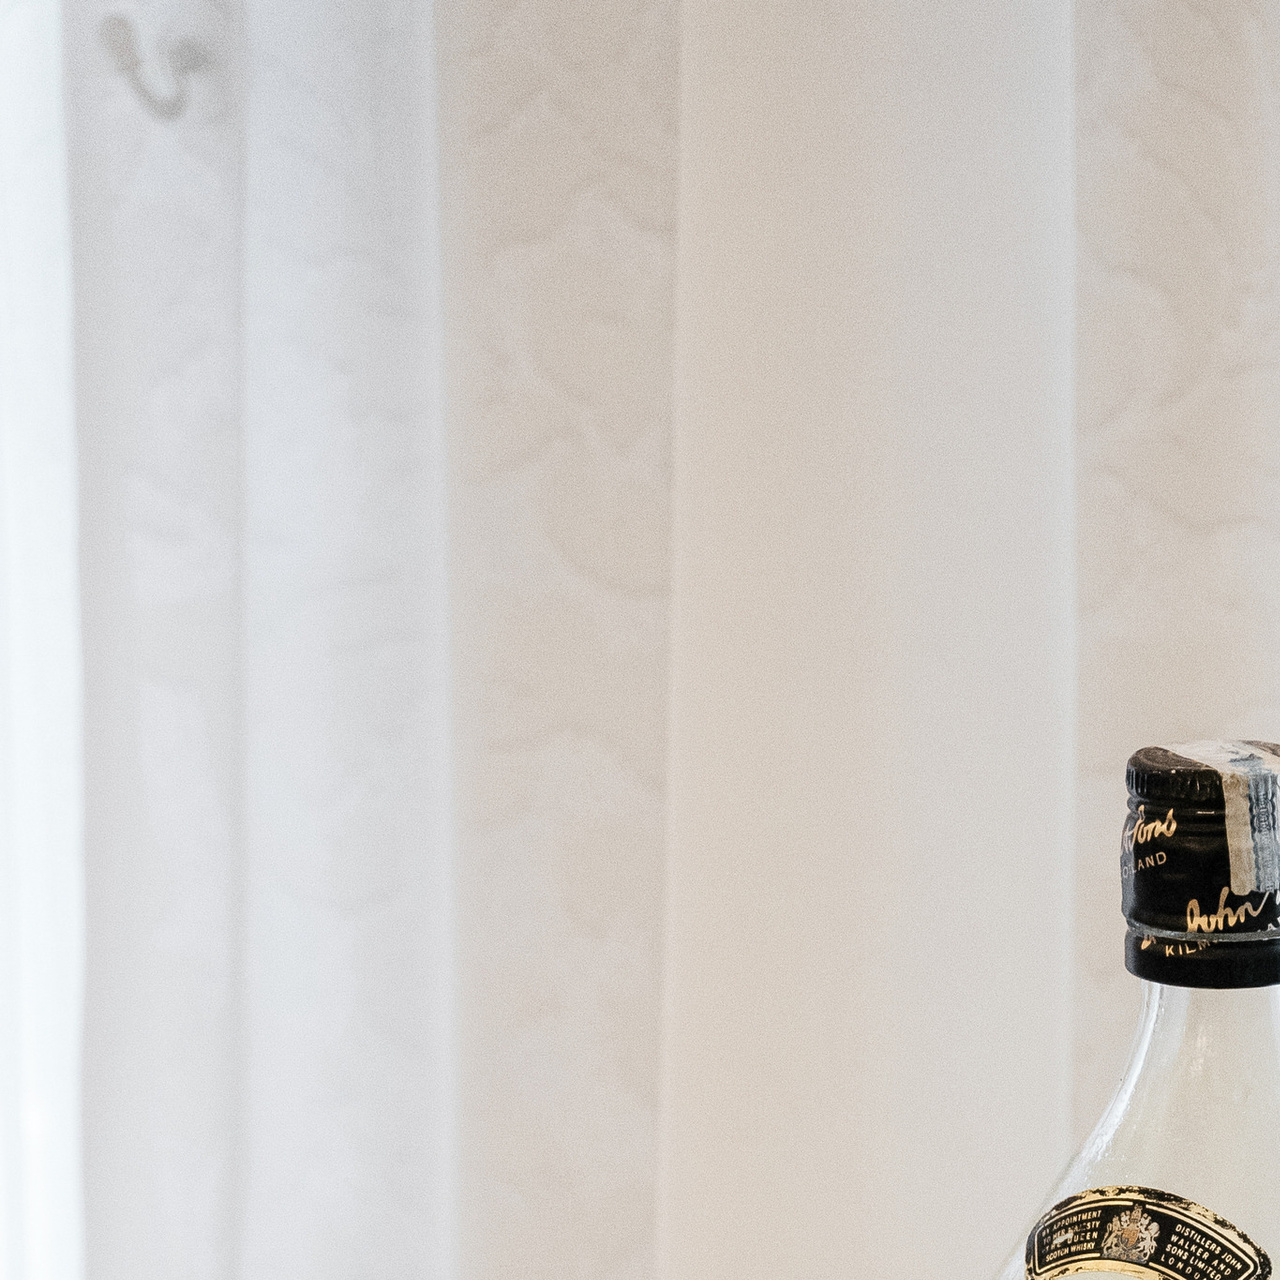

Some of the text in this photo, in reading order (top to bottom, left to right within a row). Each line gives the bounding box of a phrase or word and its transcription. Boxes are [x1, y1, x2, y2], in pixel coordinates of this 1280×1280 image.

[1053, 1210, 1102, 1230] APPOINTMENT
[1045, 1241, 1096, 1262] SCOTCH WHISKY
[1165, 1243, 1189, 1260] SONS
[1189, 1256, 1222, 1280] LIMITED
[1170, 1234, 1210, 1260] WALKER
[1211, 1259, 1232, 1276] AND
[1175, 1224, 1243, 1270] DISTILLERS JOHN
